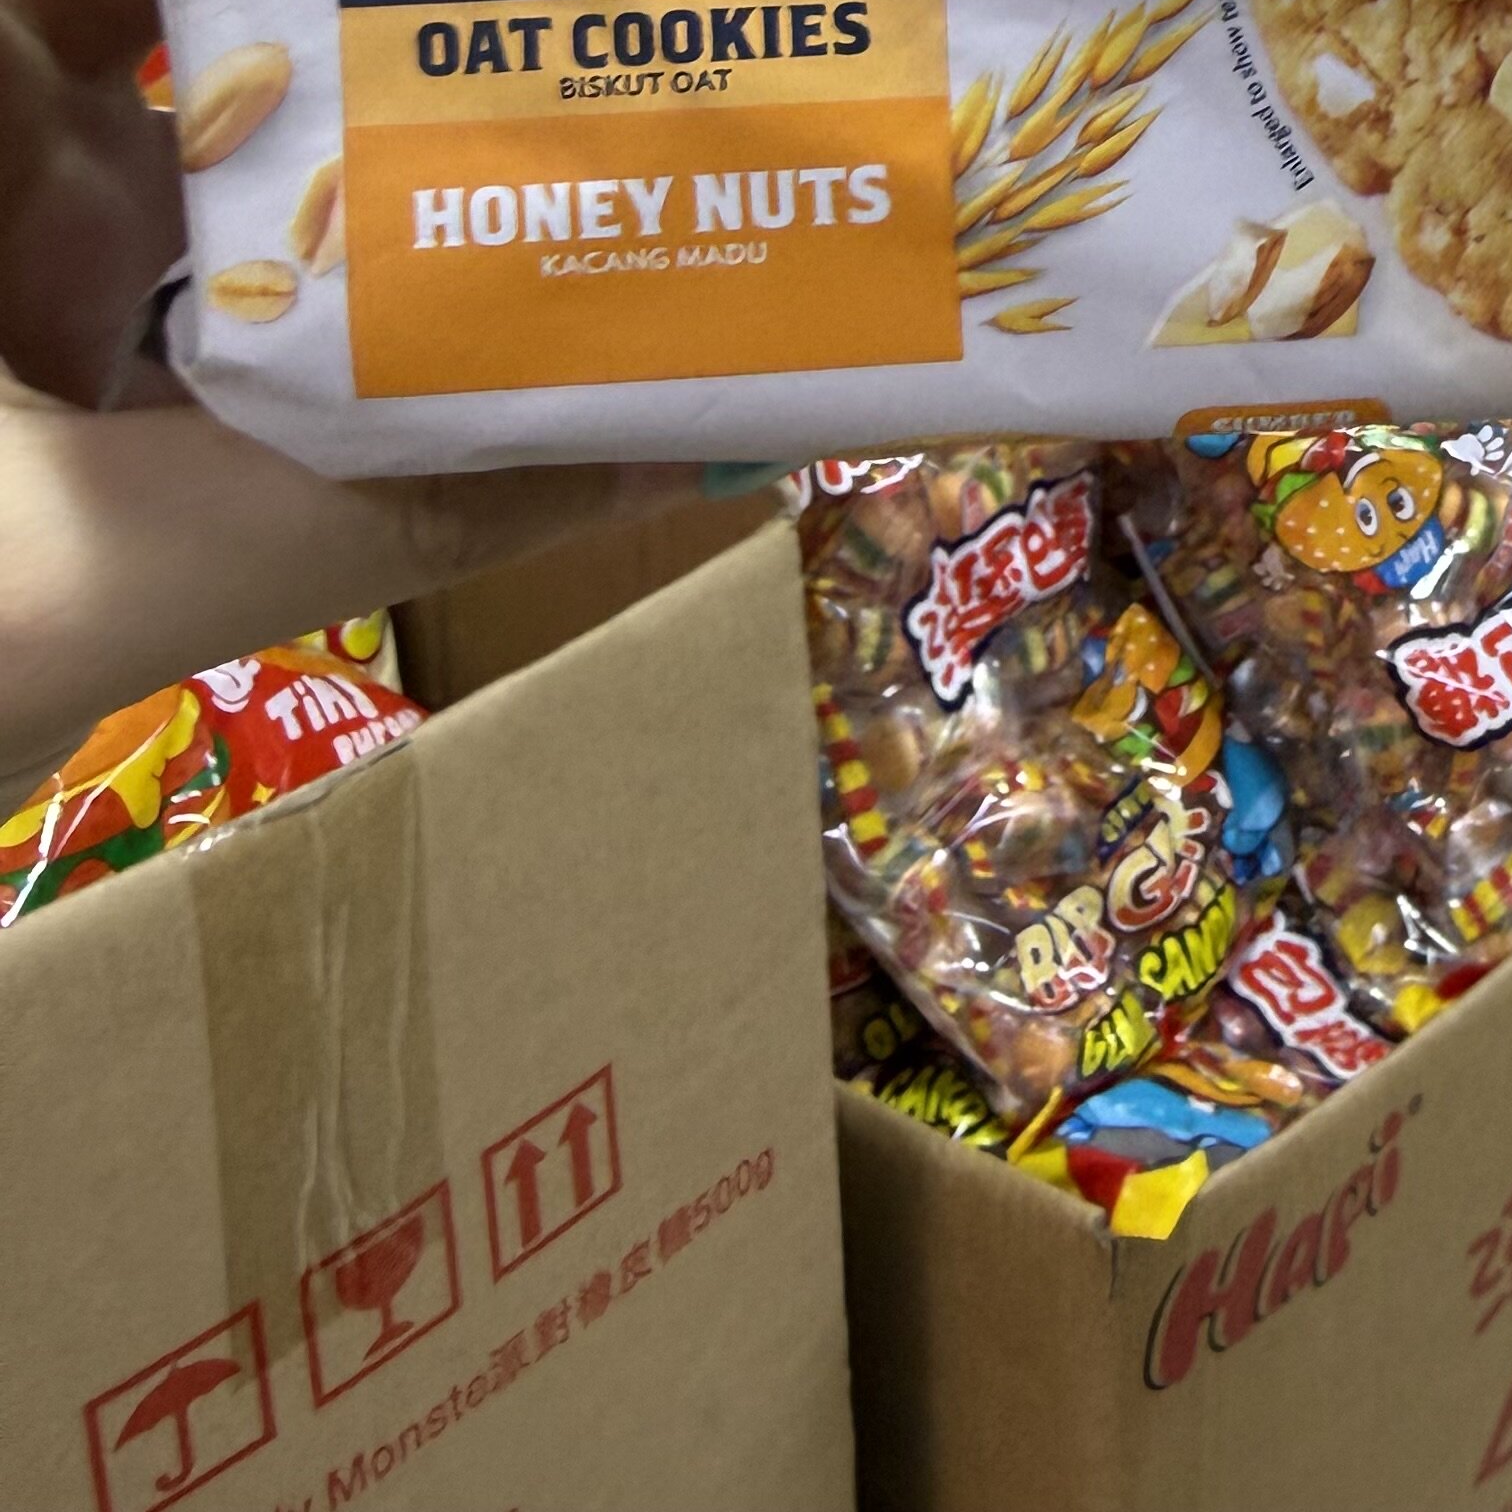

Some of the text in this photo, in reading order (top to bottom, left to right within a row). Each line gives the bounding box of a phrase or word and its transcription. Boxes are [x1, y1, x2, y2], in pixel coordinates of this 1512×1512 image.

[417, 1, 872, 77] OAT COOKIES
[1227, 26, 1258, 80] show
[560, 68, 733, 101] BISKUT OAT
[1247, 80, 1268, 106] to
[1250, 104, 1315, 192] Enlarged
[411, 164, 893, 251] HONEY NUTS
[541, 241, 768, 278] KACANG MADU
